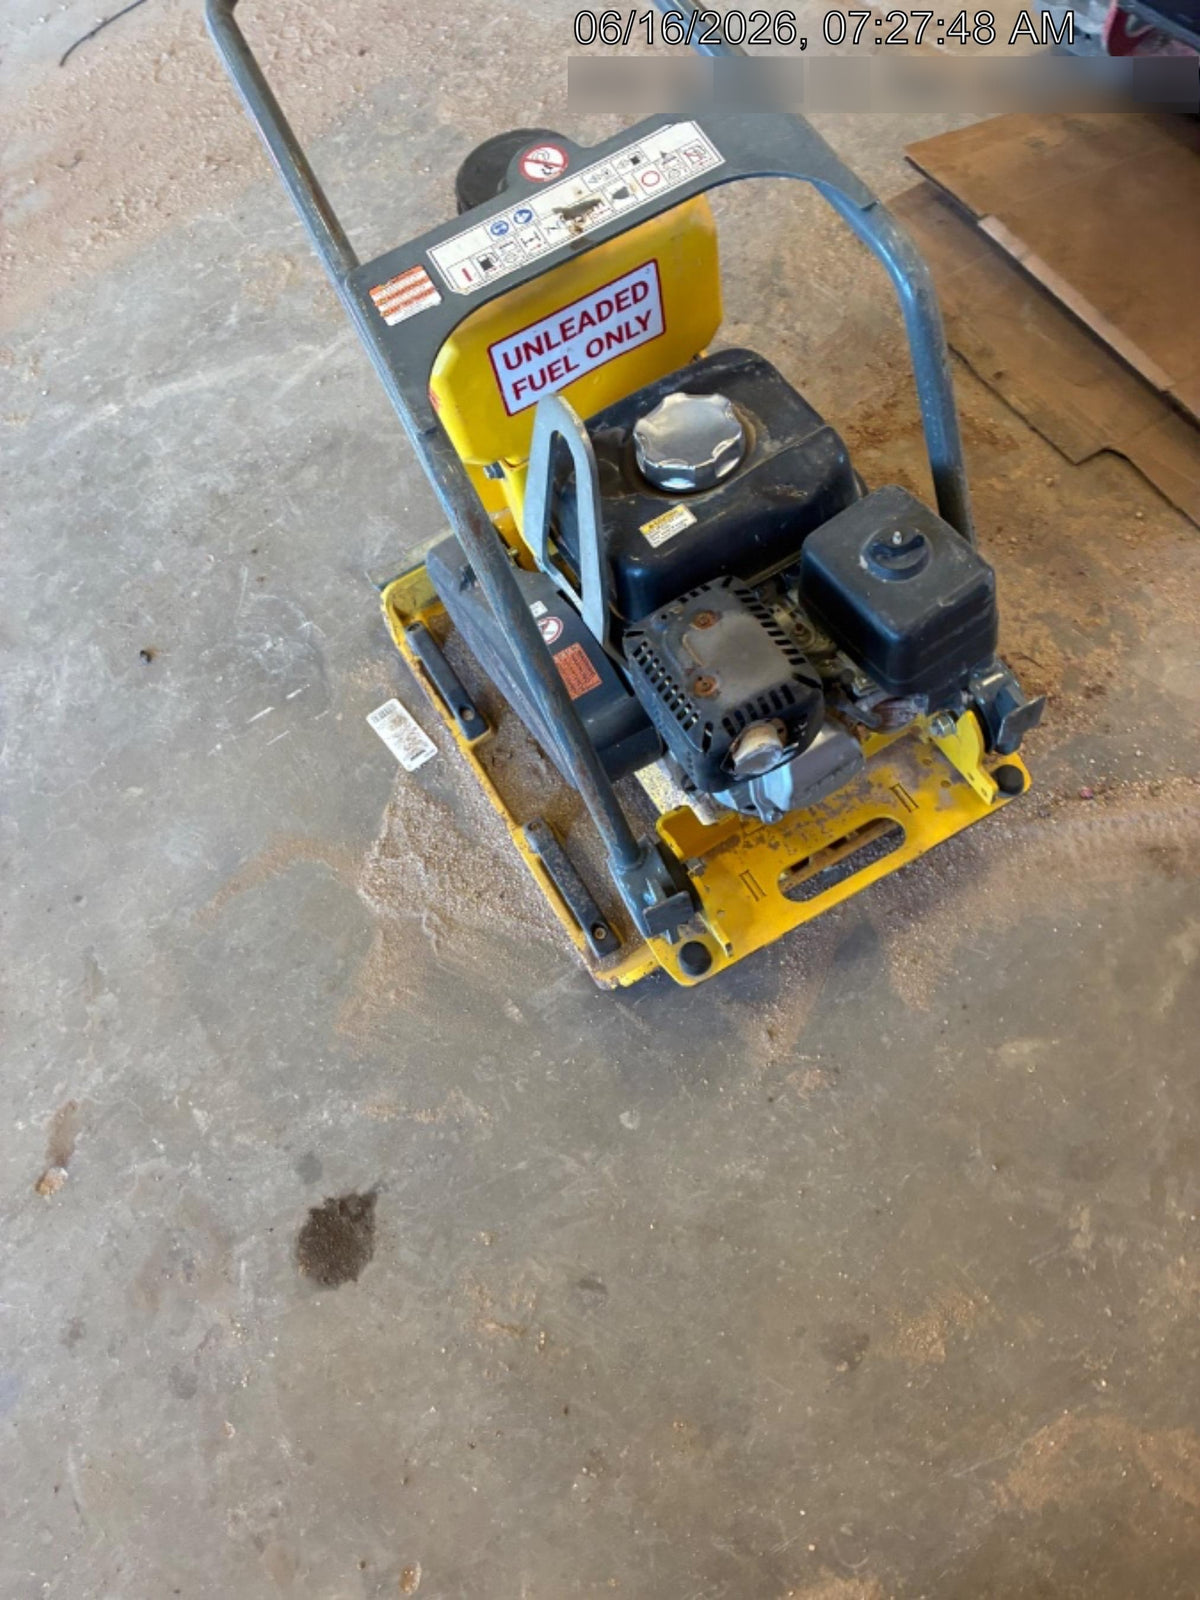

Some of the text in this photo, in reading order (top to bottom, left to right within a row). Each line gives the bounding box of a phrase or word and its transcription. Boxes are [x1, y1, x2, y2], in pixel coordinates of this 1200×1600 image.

[502, 280, 650, 371] UNLEADED
[511, 310, 652, 401] FUEL ONLY
